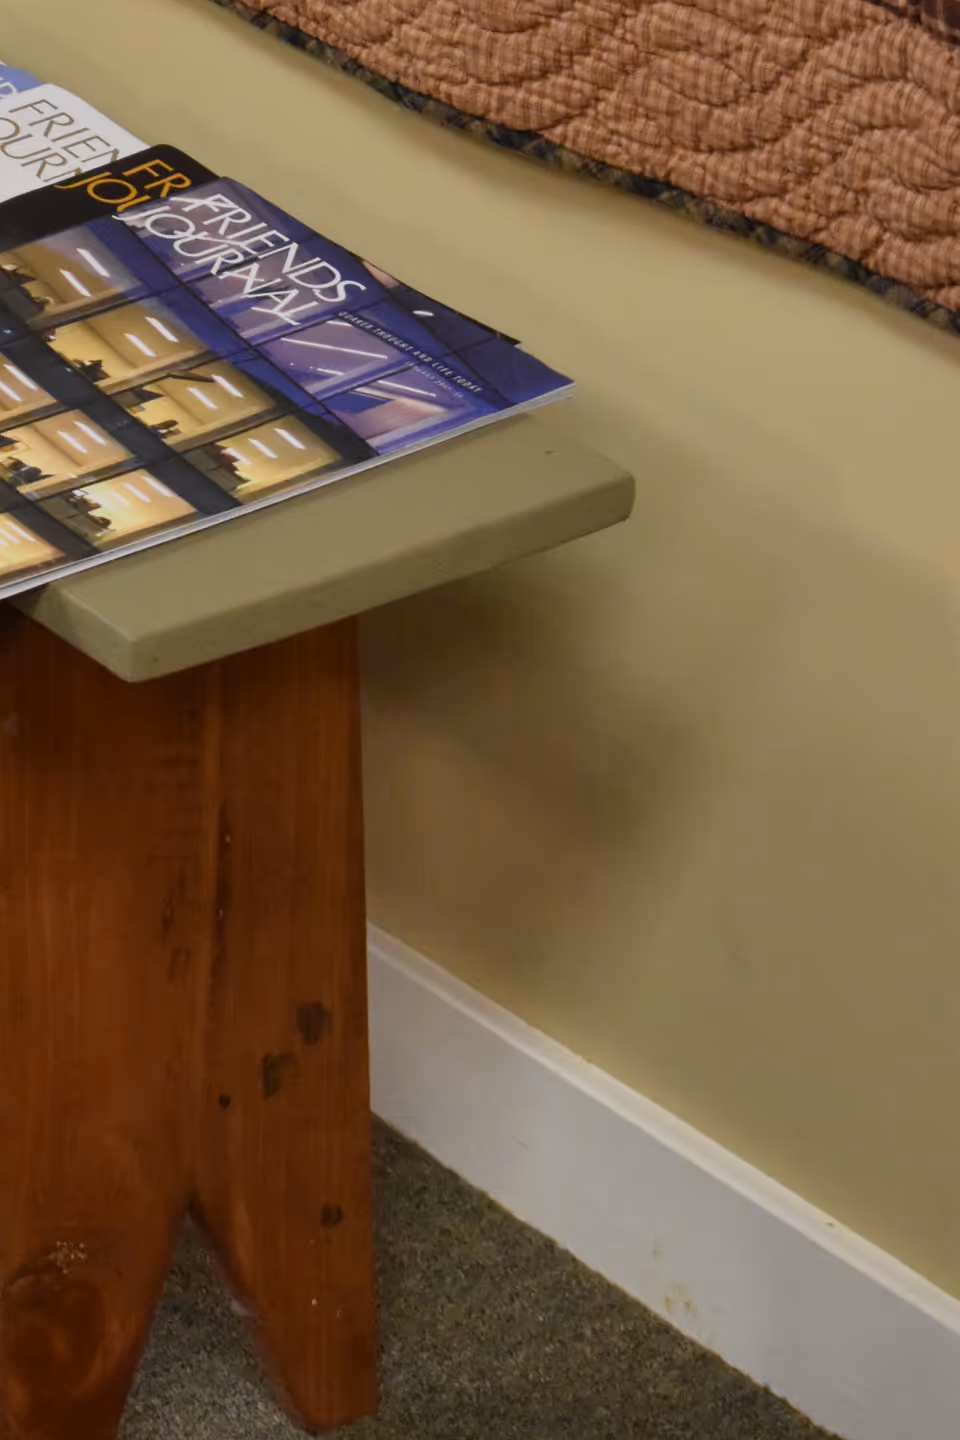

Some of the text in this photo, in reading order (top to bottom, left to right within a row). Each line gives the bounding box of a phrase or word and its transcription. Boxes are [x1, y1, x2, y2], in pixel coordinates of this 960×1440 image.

[122, 159, 192, 198] FR
[112, 205, 319, 326] JOURNAL
[176, 193, 367, 303] FRIENDS
[339, 311, 374, 331] QUAKER
[374, 327, 414, 351] THOUGHT
[412, 350, 433, 363] AND
[432, 362, 453, 377] LIFE
[452, 374, 483, 394] TODAY
